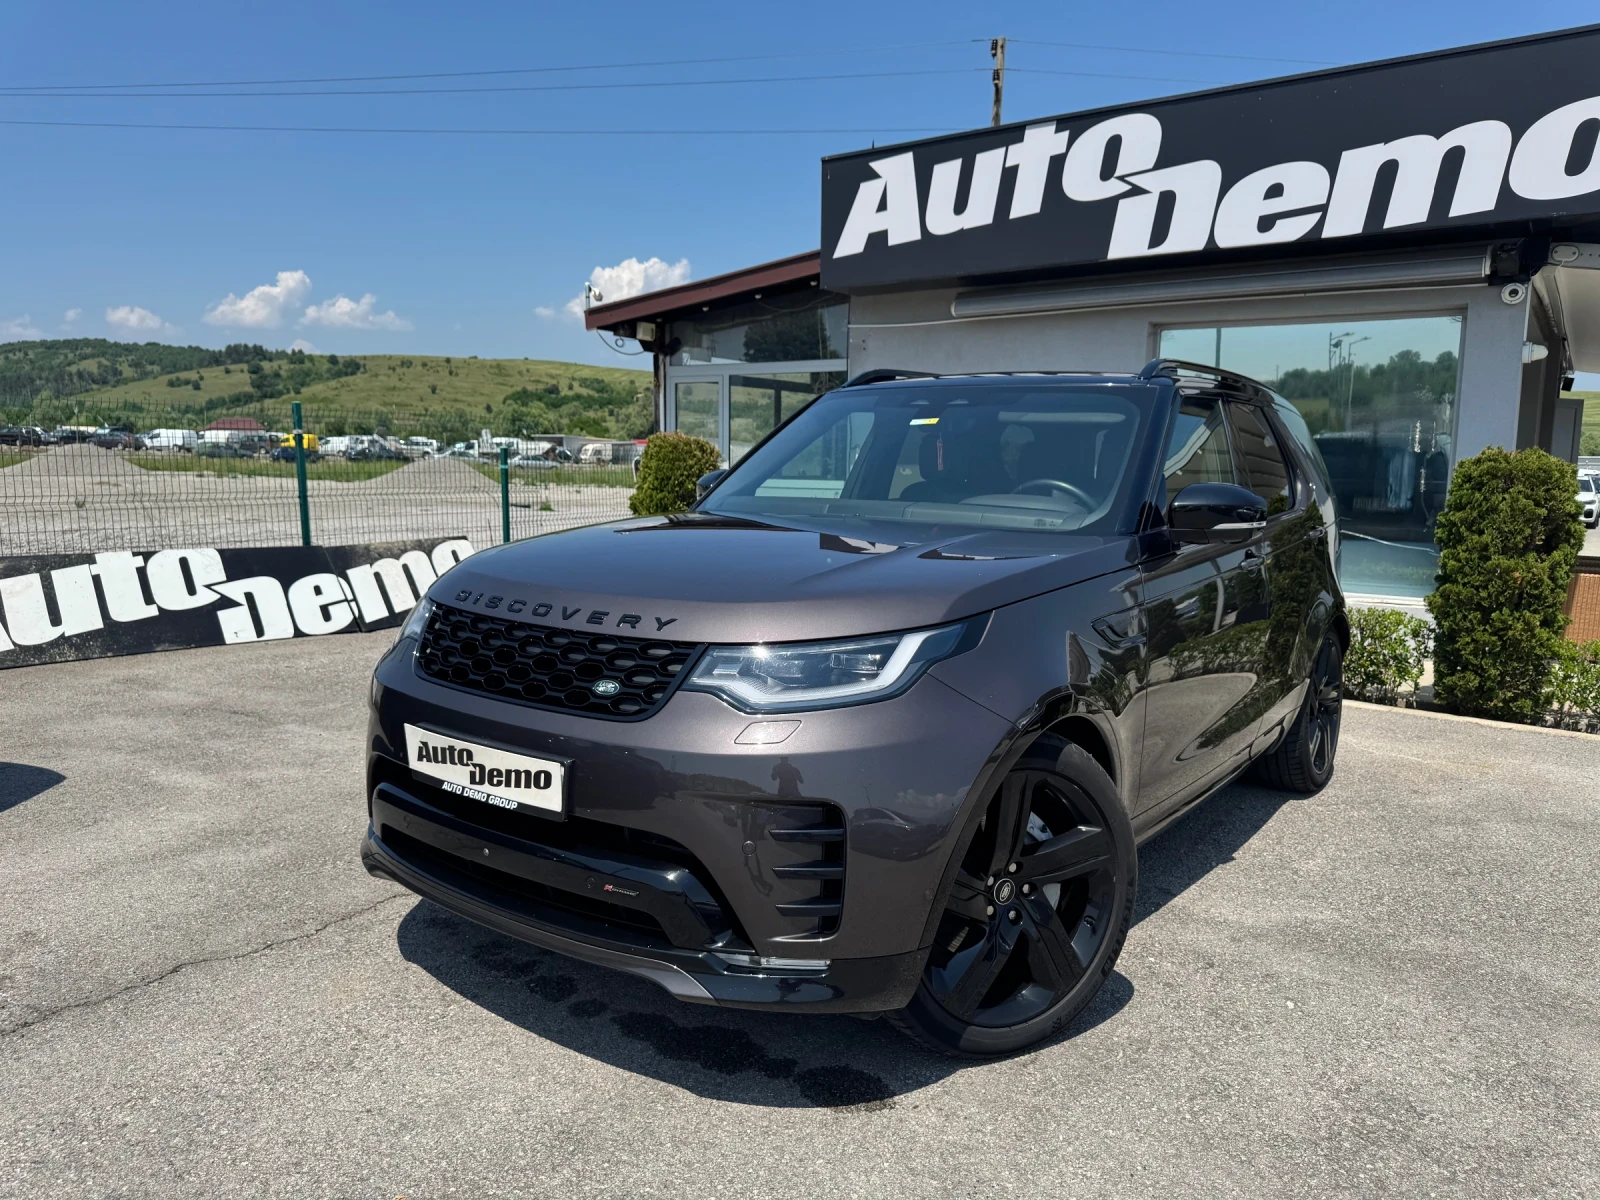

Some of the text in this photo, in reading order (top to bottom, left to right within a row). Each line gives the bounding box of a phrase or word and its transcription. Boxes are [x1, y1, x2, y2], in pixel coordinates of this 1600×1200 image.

[832, 95, 1600, 260] Auto Demo
[0, 547, 228, 652] uto
[454, 589, 679, 632] DISCOVERY
[417, 740, 553, 790] Auto Demo
[441, 781, 518, 810] AUTO DEMO GROUP
